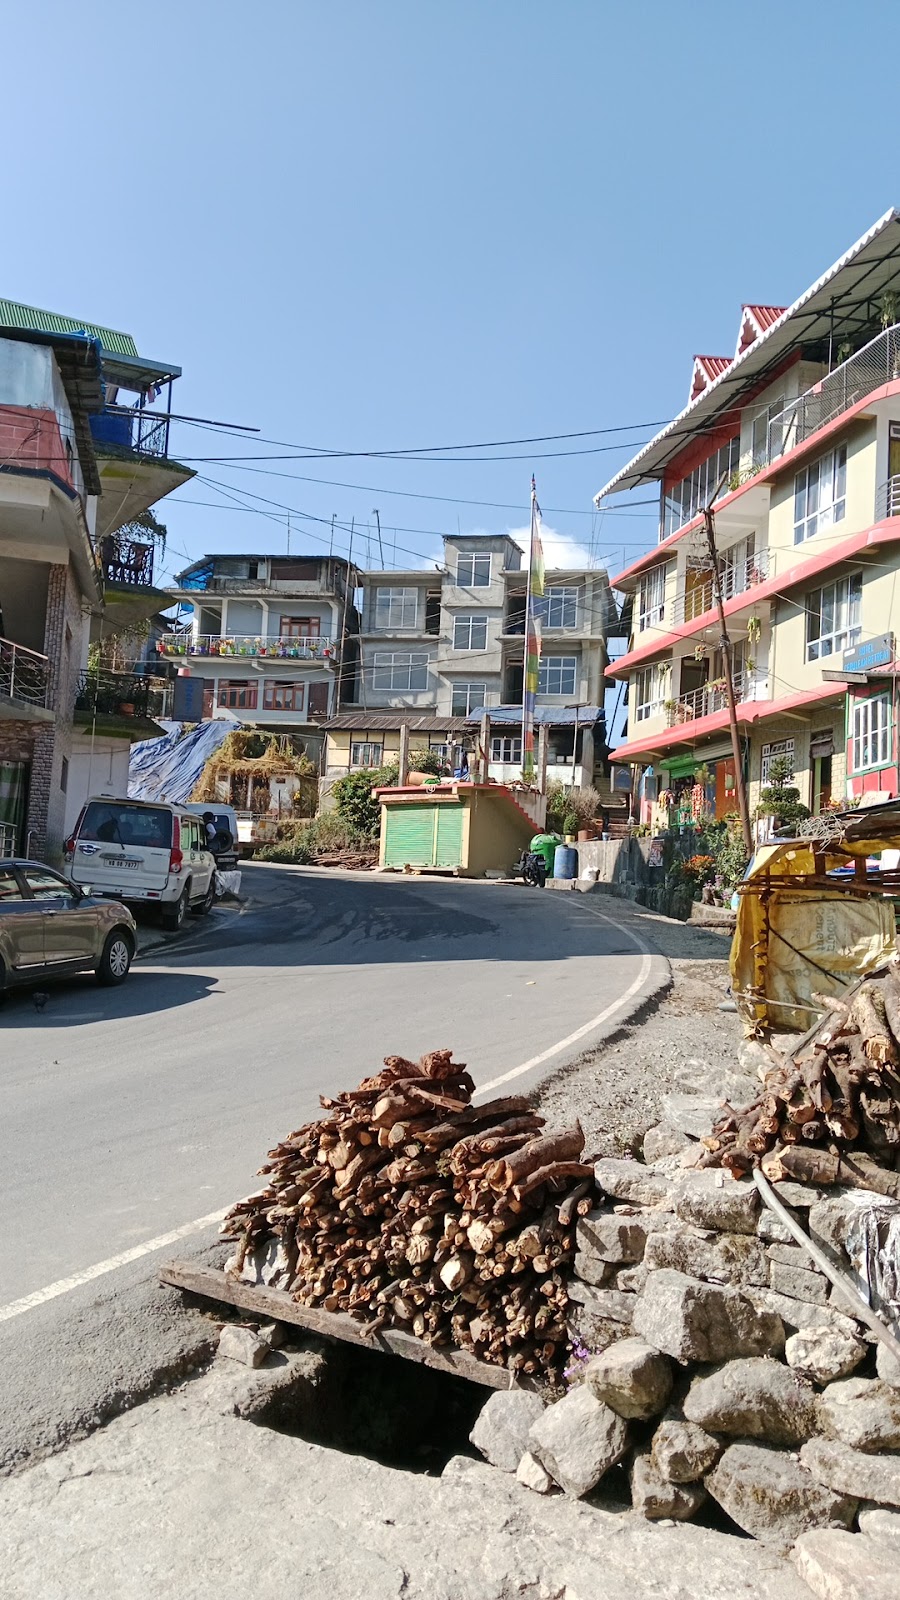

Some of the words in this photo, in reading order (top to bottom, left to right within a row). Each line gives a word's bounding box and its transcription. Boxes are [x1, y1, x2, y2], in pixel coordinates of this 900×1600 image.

[859, 643, 873, 656] HOTEL
[868, 648, 889, 665] RETREAT
[815, 907, 826, 951] Cement
